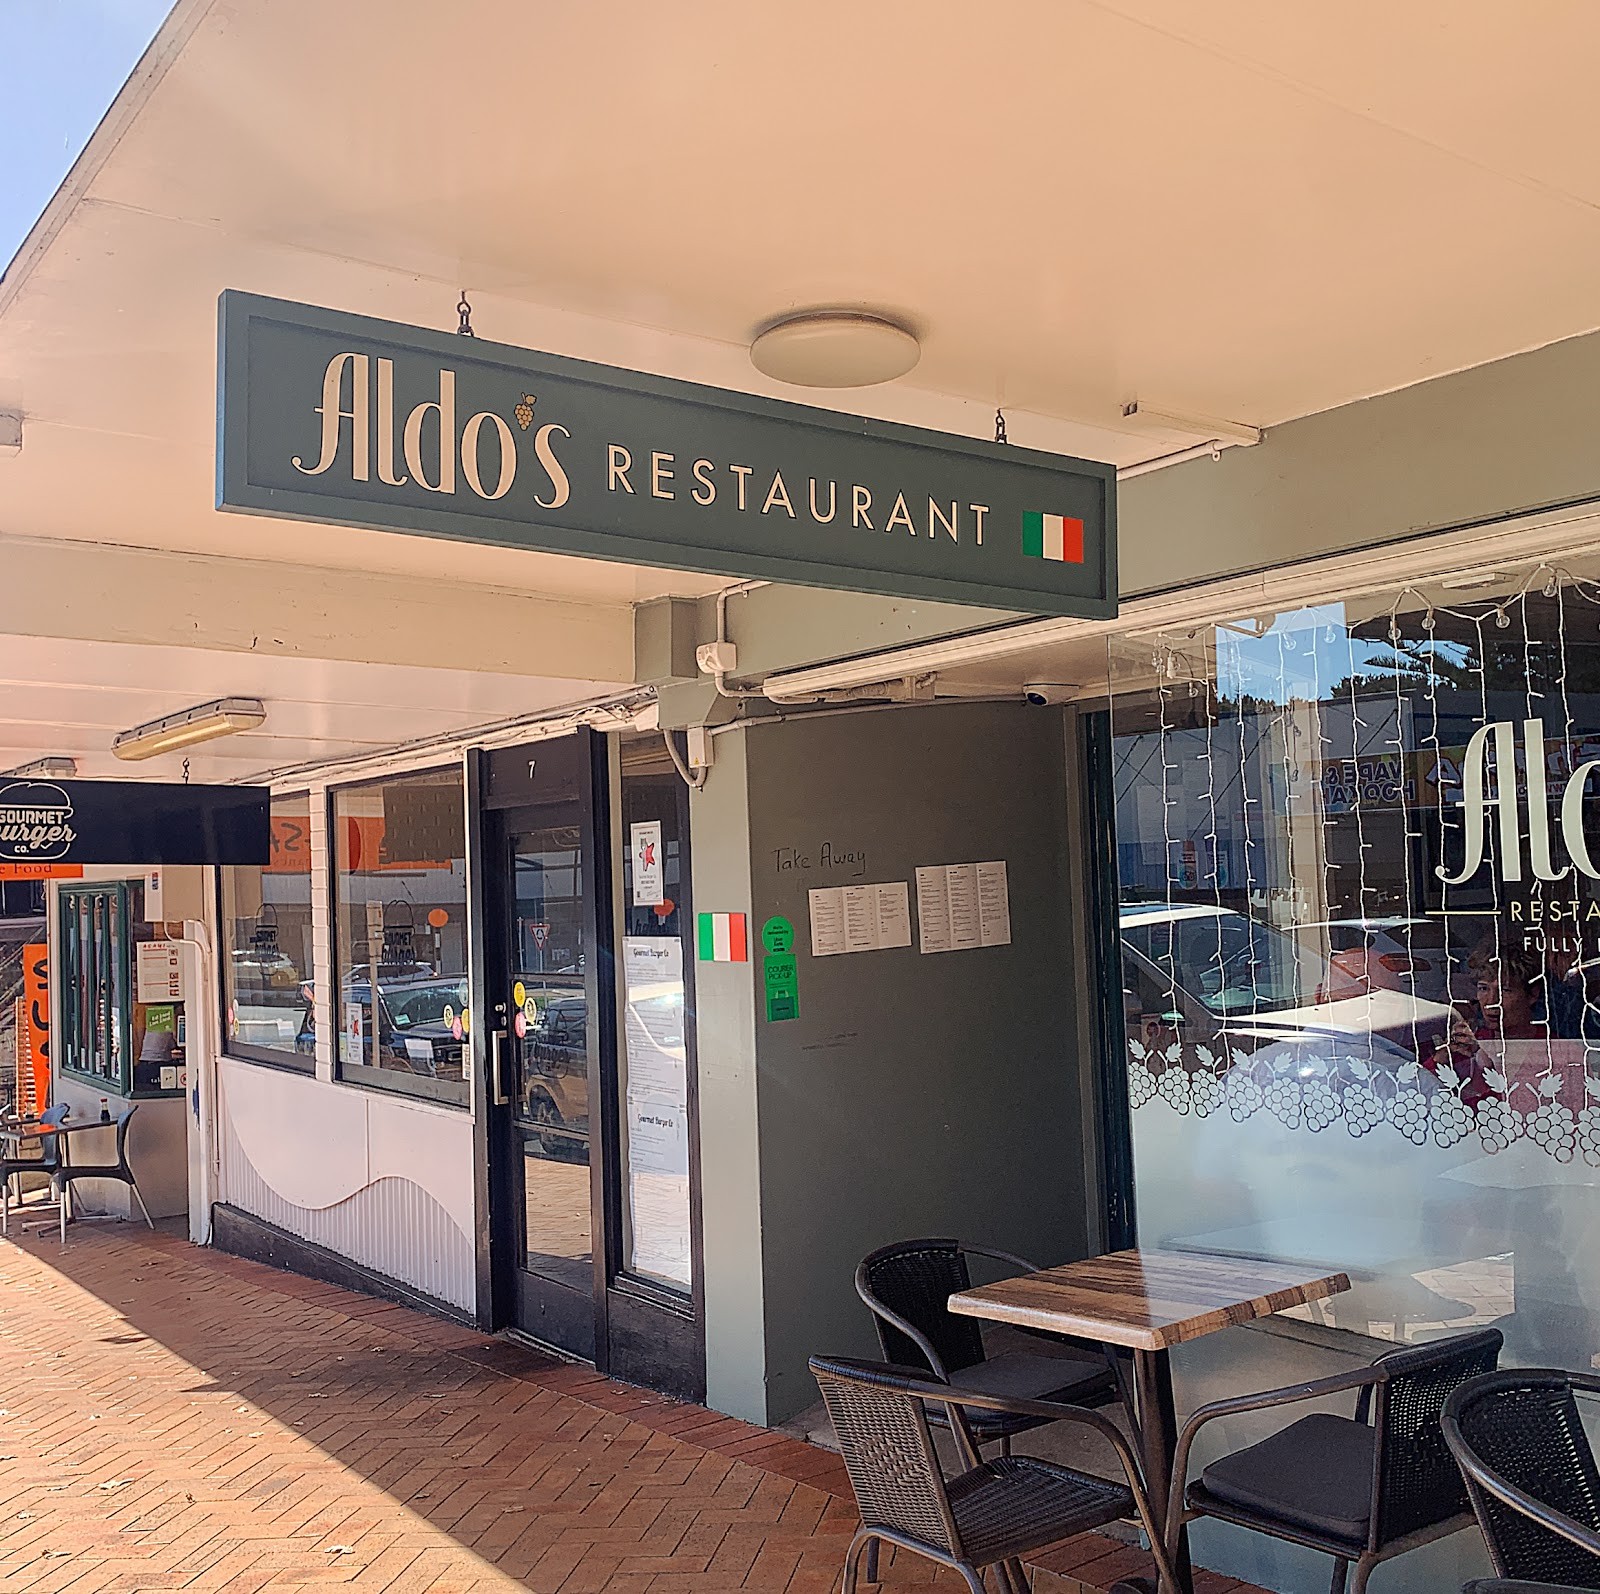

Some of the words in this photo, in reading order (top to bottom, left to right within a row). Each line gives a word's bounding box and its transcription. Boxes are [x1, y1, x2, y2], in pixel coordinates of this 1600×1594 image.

[290, 351, 571, 510] Aldo's
[606, 442, 990, 547] RESTAURANT
[528, 760, 536, 779] 7
[0, 823, 77, 850] urger
[14, 845, 30, 853] CO.
[14, 862, 52, 875] Food
[771, 847, 811, 873] Take
[820, 842, 866, 877] Away
[1523, 936, 1583, 953] FULLY
